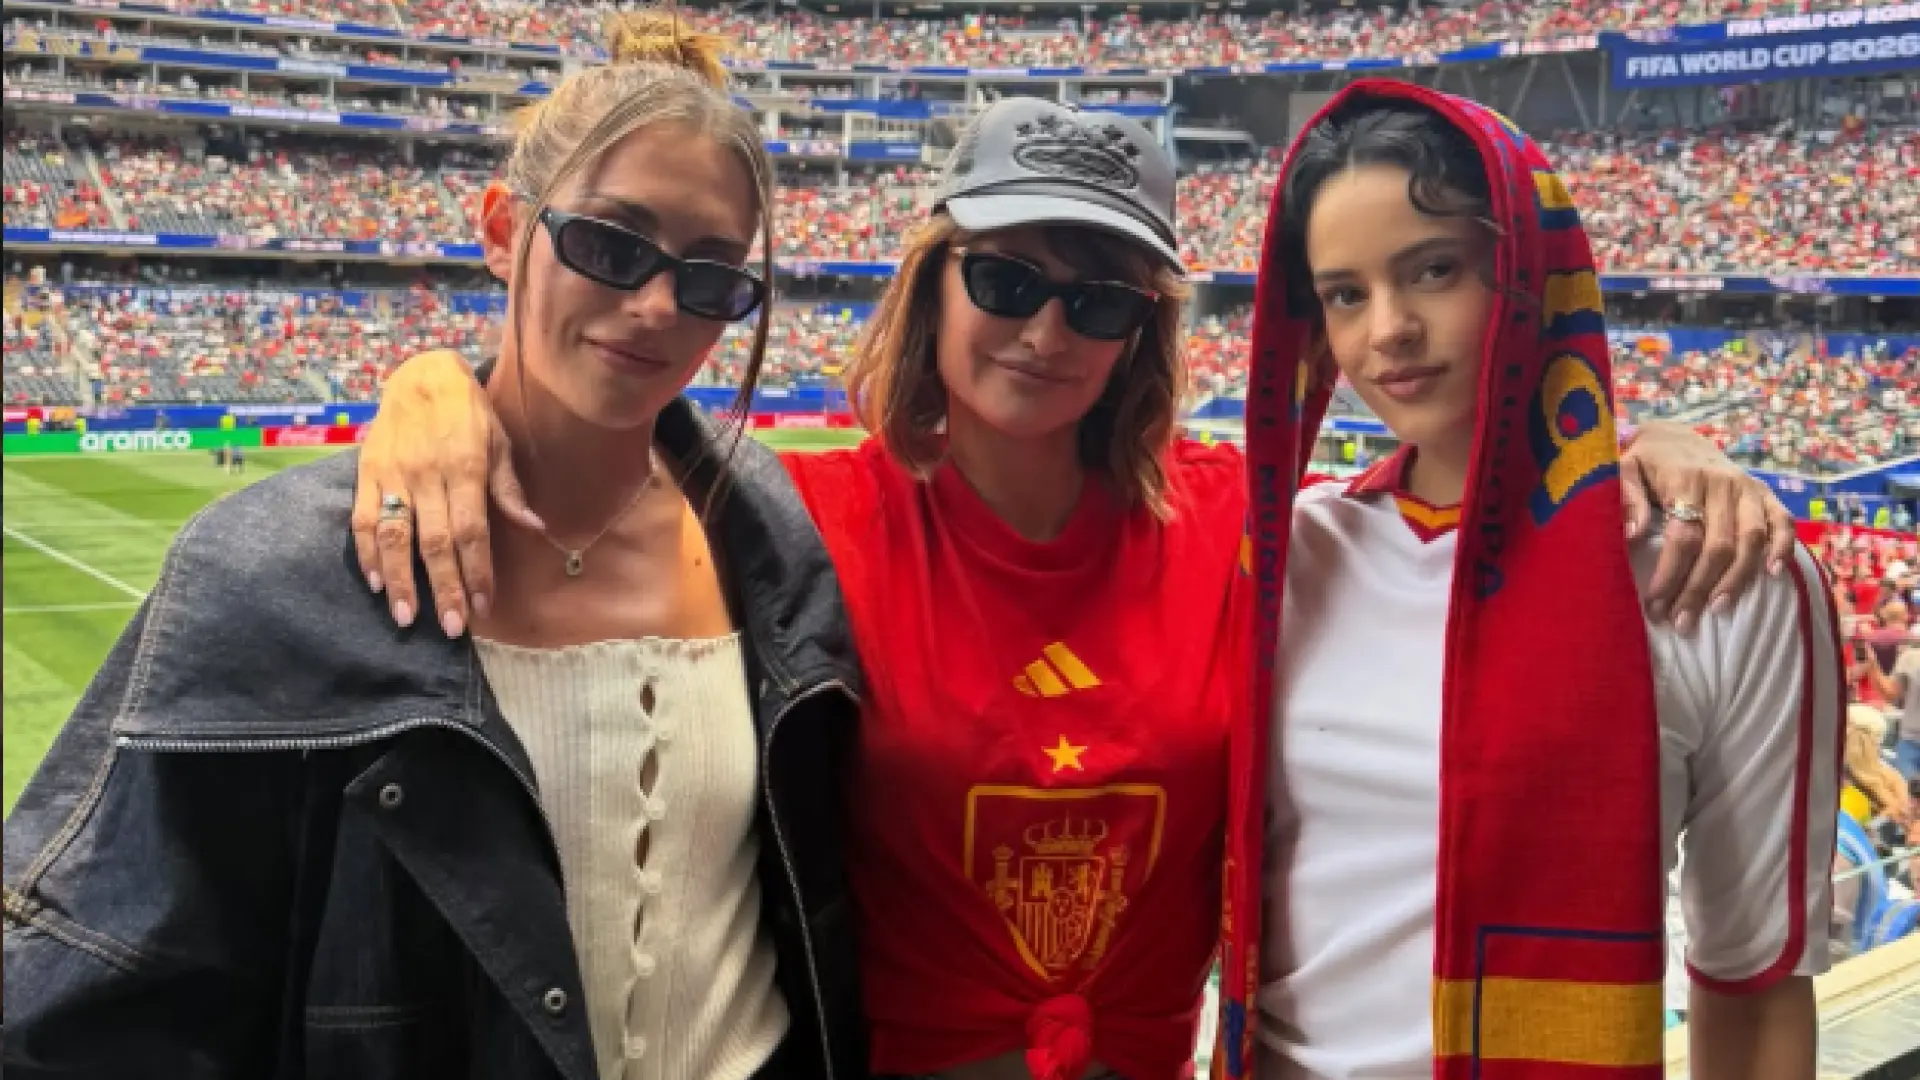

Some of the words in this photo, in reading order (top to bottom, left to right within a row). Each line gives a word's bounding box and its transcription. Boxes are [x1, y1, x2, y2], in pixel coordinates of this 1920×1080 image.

[1625, 55, 1678, 79] FIFA
[1681, 48, 1770, 76] WORLD
[1773, 42, 1826, 67] CUP
[1827, 33, 1920, 64] 2026
[80, 430, 191, 453] aramco
